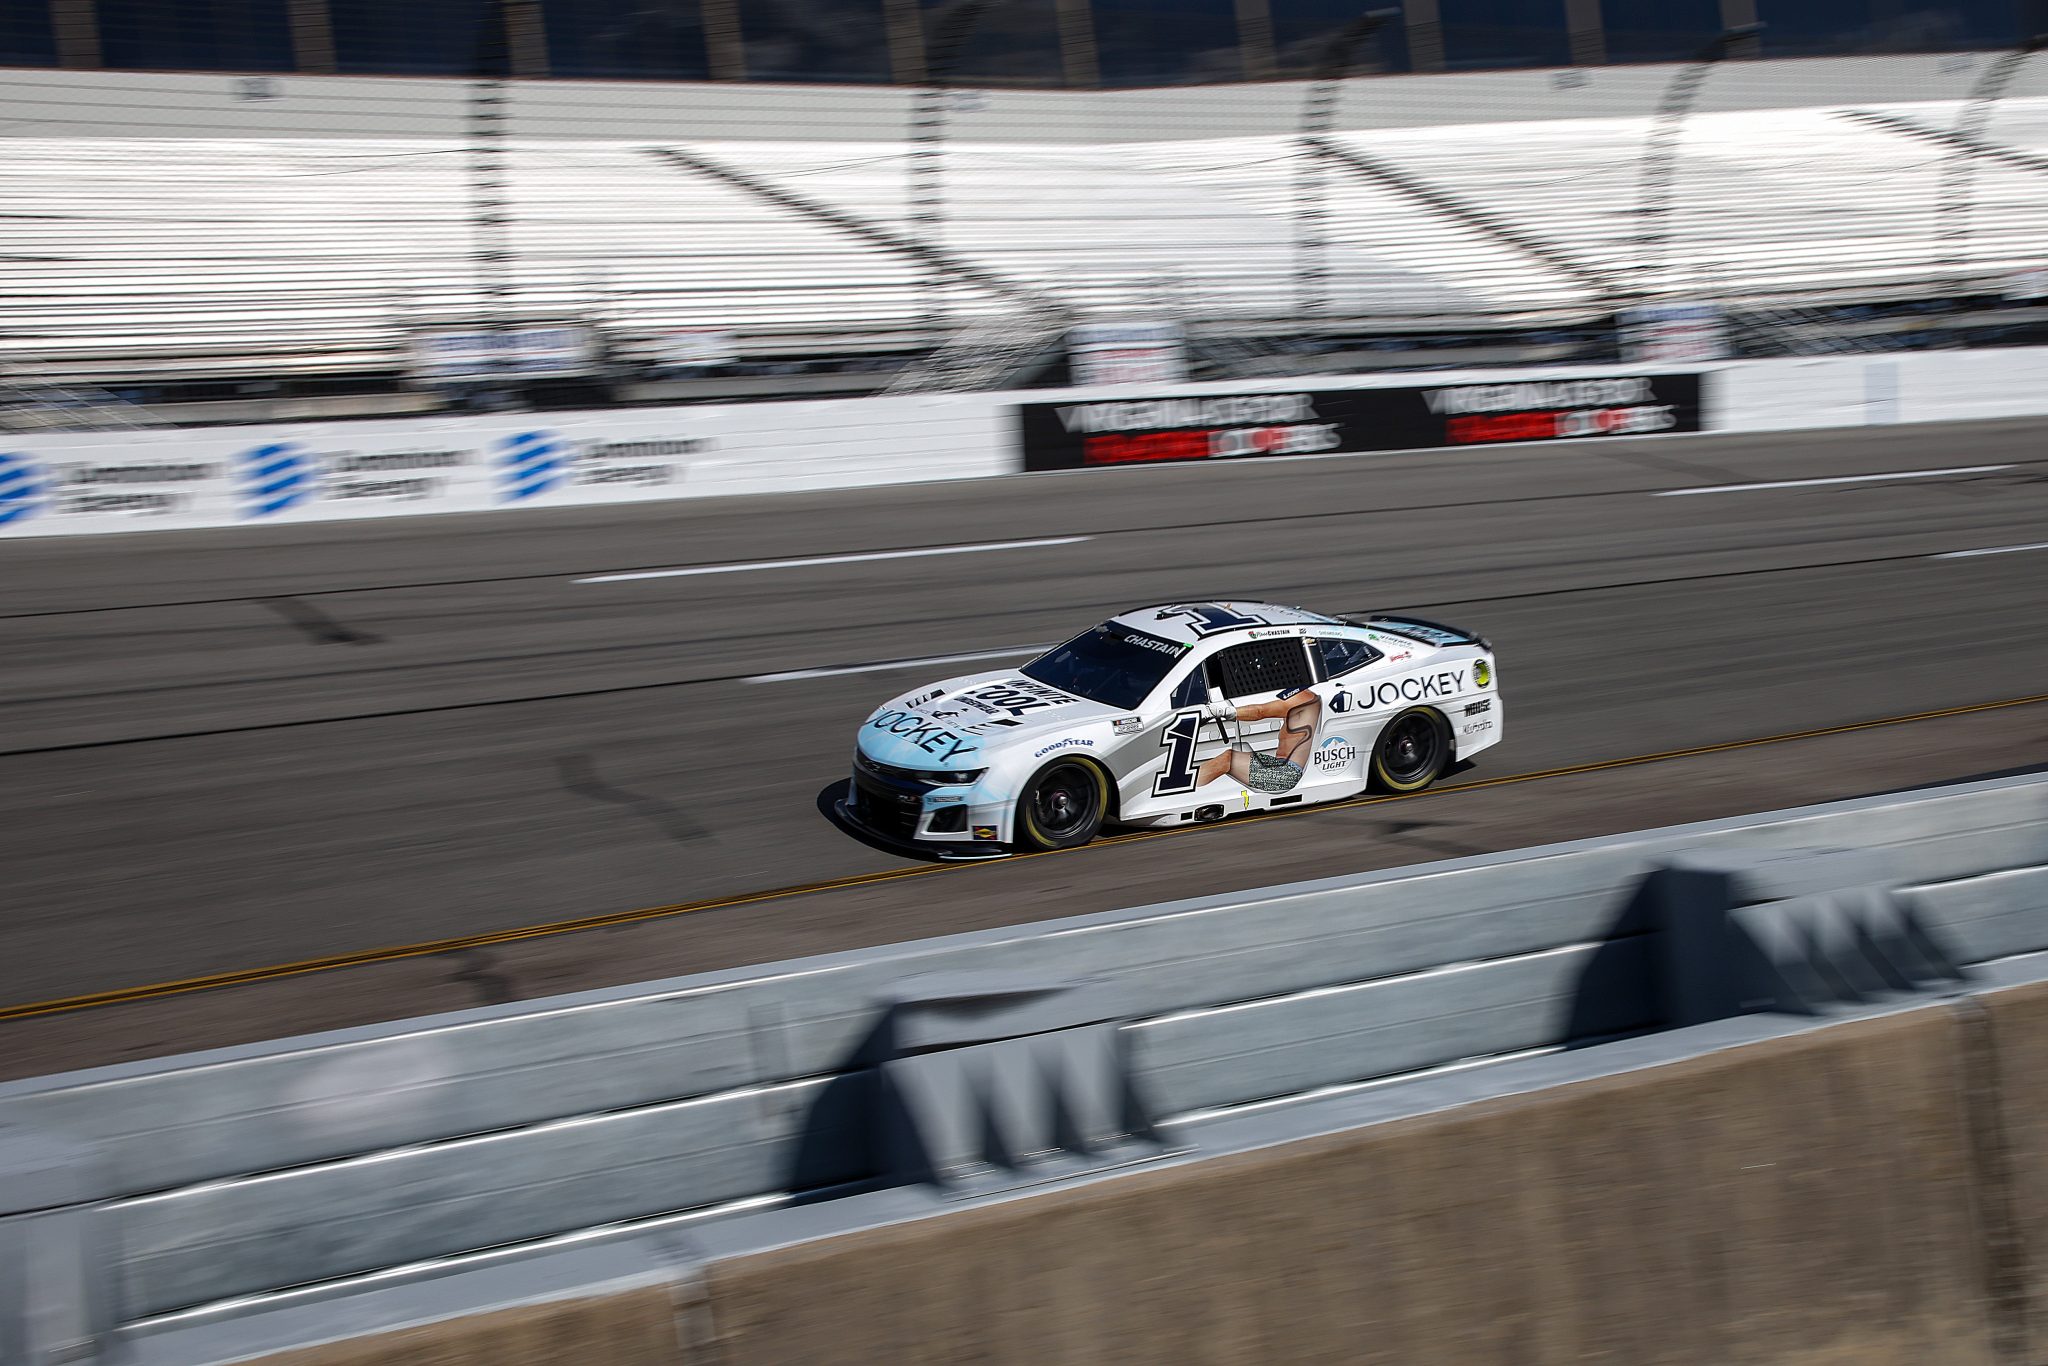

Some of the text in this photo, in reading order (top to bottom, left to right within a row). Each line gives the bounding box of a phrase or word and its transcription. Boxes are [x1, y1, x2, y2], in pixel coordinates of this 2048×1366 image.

[1123, 634, 1187, 659] CHASTAIN
[1357, 669, 1465, 710] JOCKEY
[866, 710, 978, 763] JOCKEY
[1034, 737, 1094, 758] GOODYEAR
[1151, 709, 1202, 798] 1
[1313, 746, 1356, 765] BUSCH
[1321, 760, 1347, 771] LIGHT
